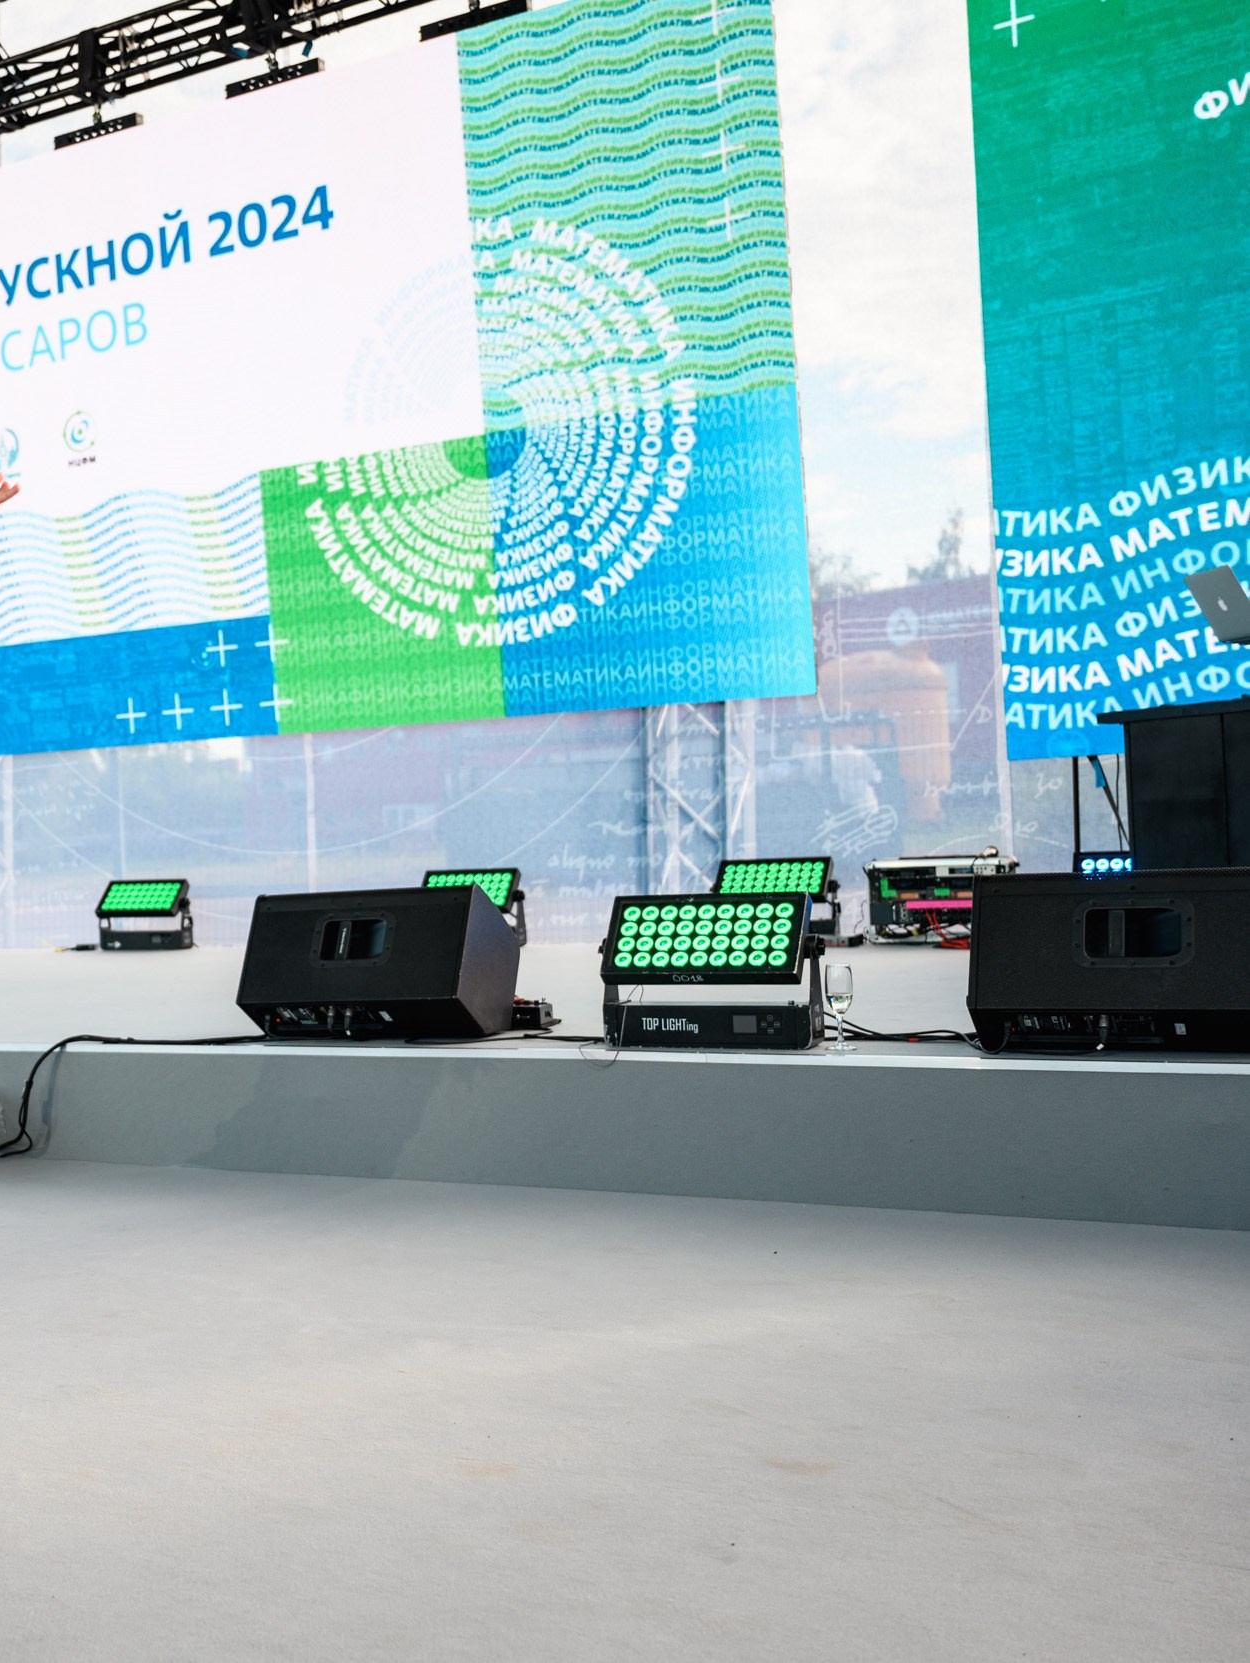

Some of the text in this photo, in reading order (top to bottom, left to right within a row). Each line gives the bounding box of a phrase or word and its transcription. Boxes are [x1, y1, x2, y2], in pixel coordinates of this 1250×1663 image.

[207, 184, 335, 258] 2024
[0, 302, 149, 373] САРОВ
[582, 378, 698, 607] ИНФОРМАТИКА
[304, 498, 441, 639] МАТЕМАТИКА
[335, 501, 460, 613] МАТЕМАТИКА
[486, 543, 573, 589] ФИЗИКА
[1111, 538, 1250, 600] ИНФО
[472, 570, 576, 615] ФИЗИКА
[455, 603, 578, 647] ФИЗИКА
[1116, 626, 1250, 682] МАТЕ
[642, 1017, 699, 1034] TOP LIGHTing
